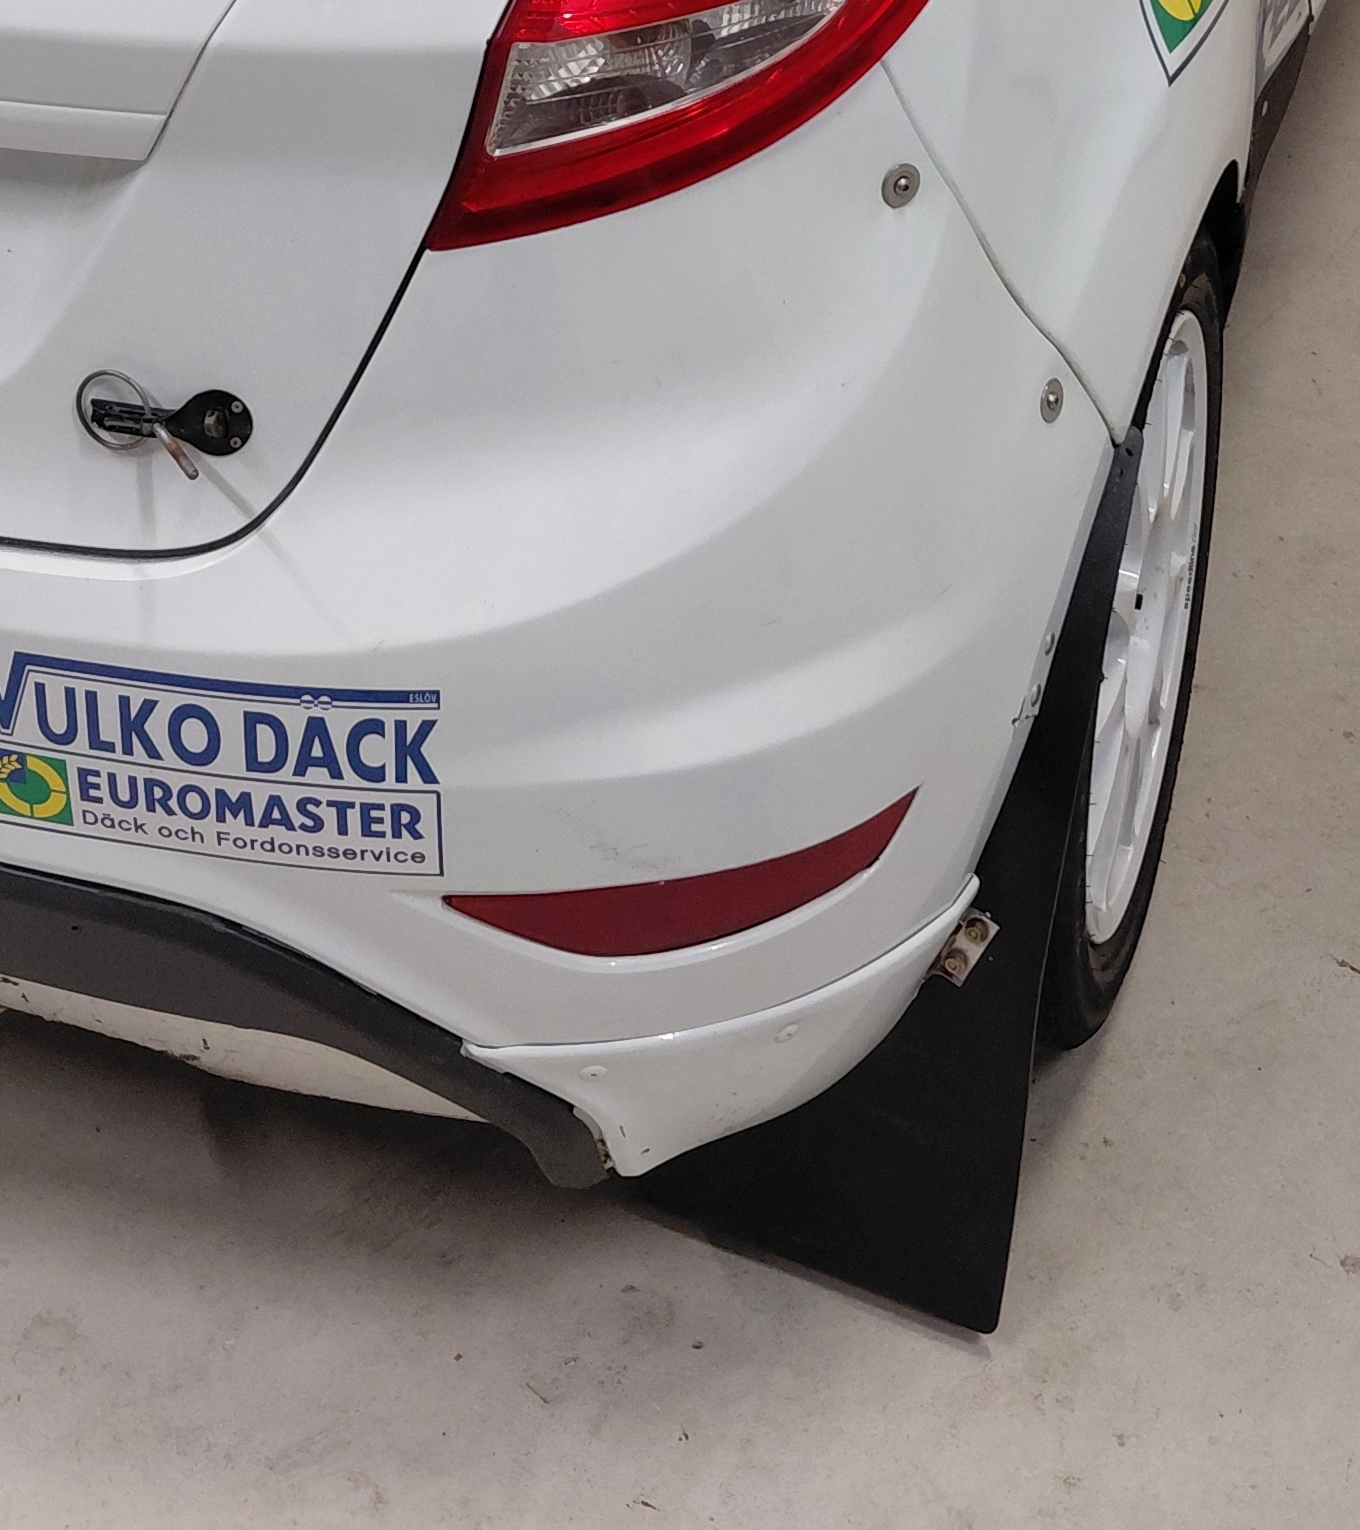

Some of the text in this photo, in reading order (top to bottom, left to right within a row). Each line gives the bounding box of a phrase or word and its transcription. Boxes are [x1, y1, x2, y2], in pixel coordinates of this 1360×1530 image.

[77, 767, 425, 841] EUROMASTER
[82, 809, 427, 865] Däck och Fordonsservice
